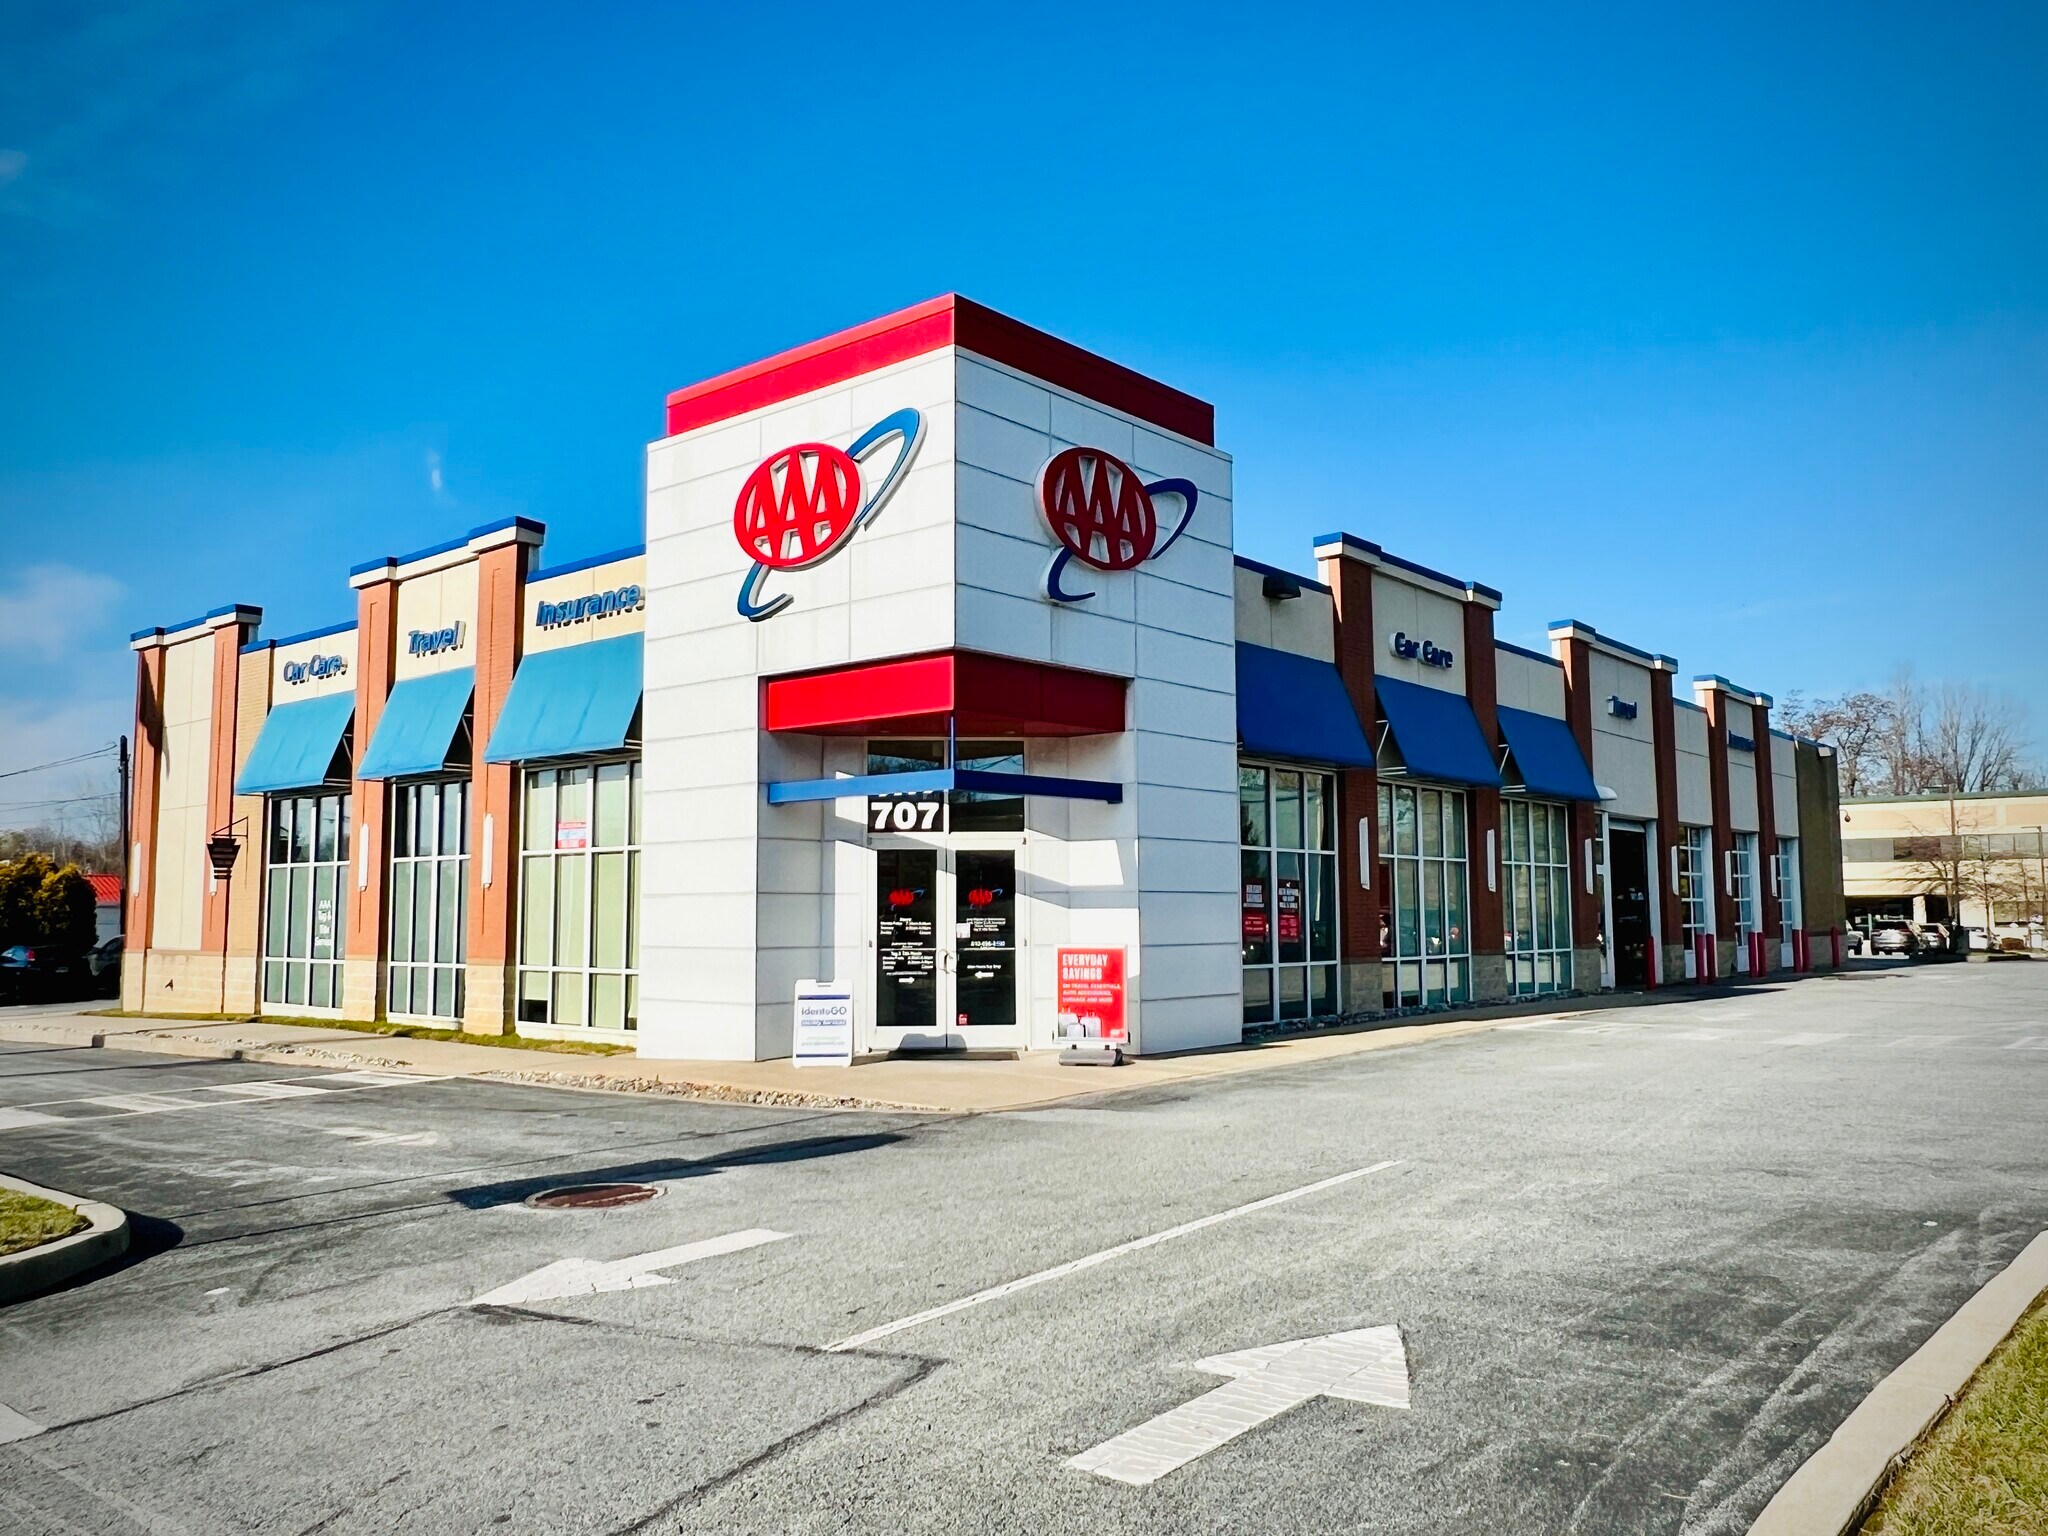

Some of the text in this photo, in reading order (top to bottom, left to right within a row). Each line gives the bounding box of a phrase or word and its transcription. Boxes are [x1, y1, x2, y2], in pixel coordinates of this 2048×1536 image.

[739, 446, 857, 564] AAA
[1047, 450, 1153, 567] AAA
[536, 585, 640, 626] Insurance
[408, 620, 460, 654] Travel
[1394, 631, 1453, 668] Car Care
[284, 655, 343, 682] Car Care
[871, 801, 939, 830] 707
[1062, 953, 1108, 967] EVERYDAY
[1062, 967, 1103, 980] SAVINGS
